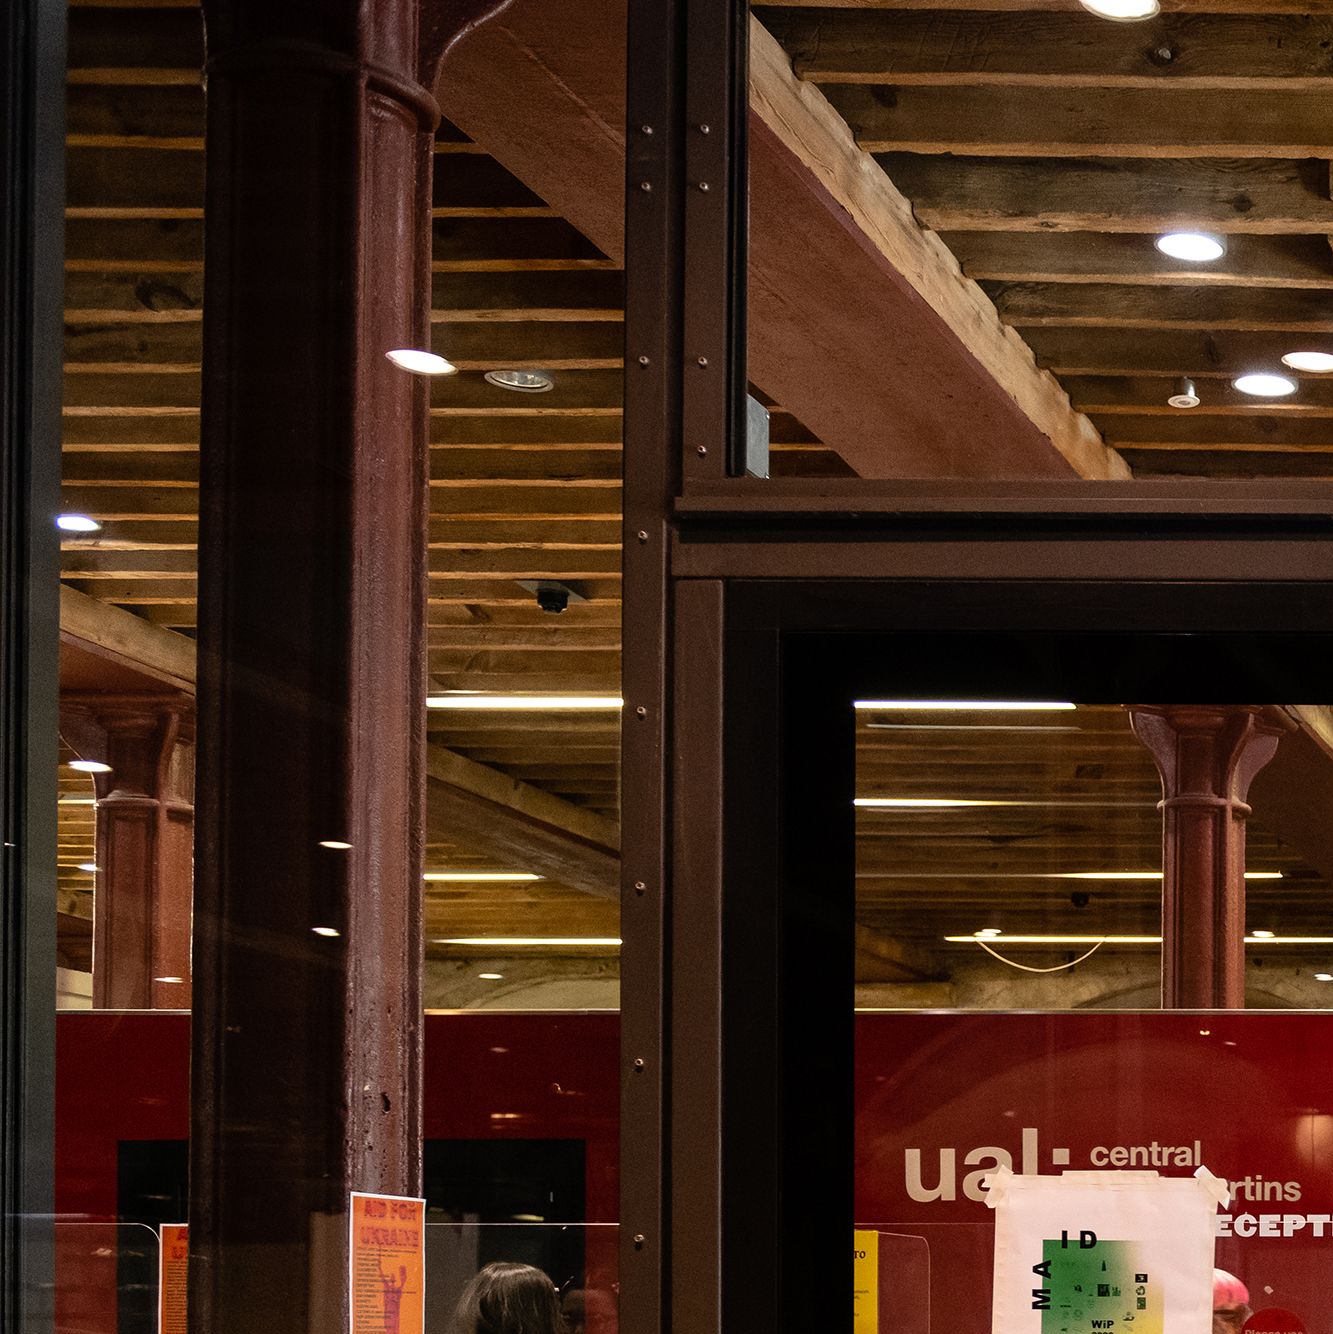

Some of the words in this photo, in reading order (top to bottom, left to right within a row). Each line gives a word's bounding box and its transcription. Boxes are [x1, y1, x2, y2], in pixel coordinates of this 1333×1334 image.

[1090, 1140, 1201, 1166] central
[1222, 1175, 1301, 1201] rtins
[1091, 1320, 1115, 1329] WiP
